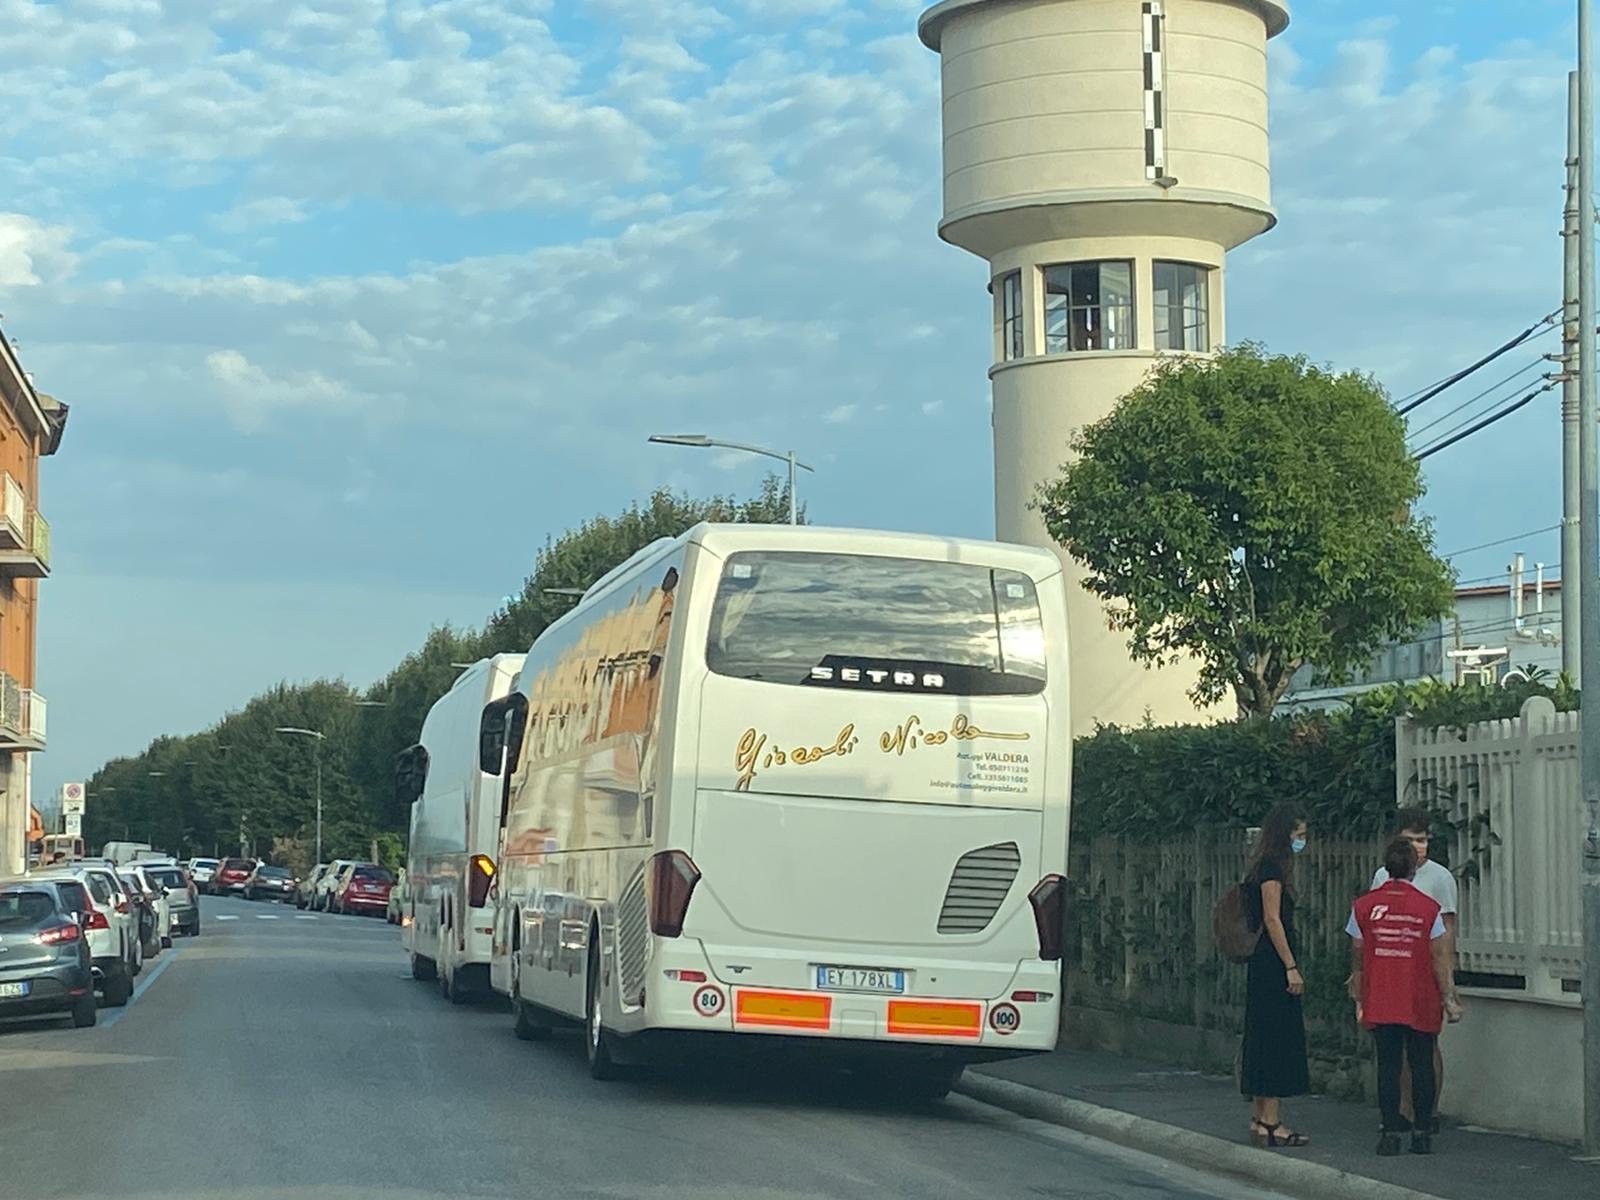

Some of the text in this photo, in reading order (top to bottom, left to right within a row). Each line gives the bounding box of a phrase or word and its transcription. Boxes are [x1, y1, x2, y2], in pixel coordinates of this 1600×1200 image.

[811, 667, 944, 688] SETRA
[828, 969, 894, 989] EY 178XL
[0, 984, 21, 994] 6ZS
[702, 993, 717, 1007] 80
[996, 1012, 1015, 1026] 100
